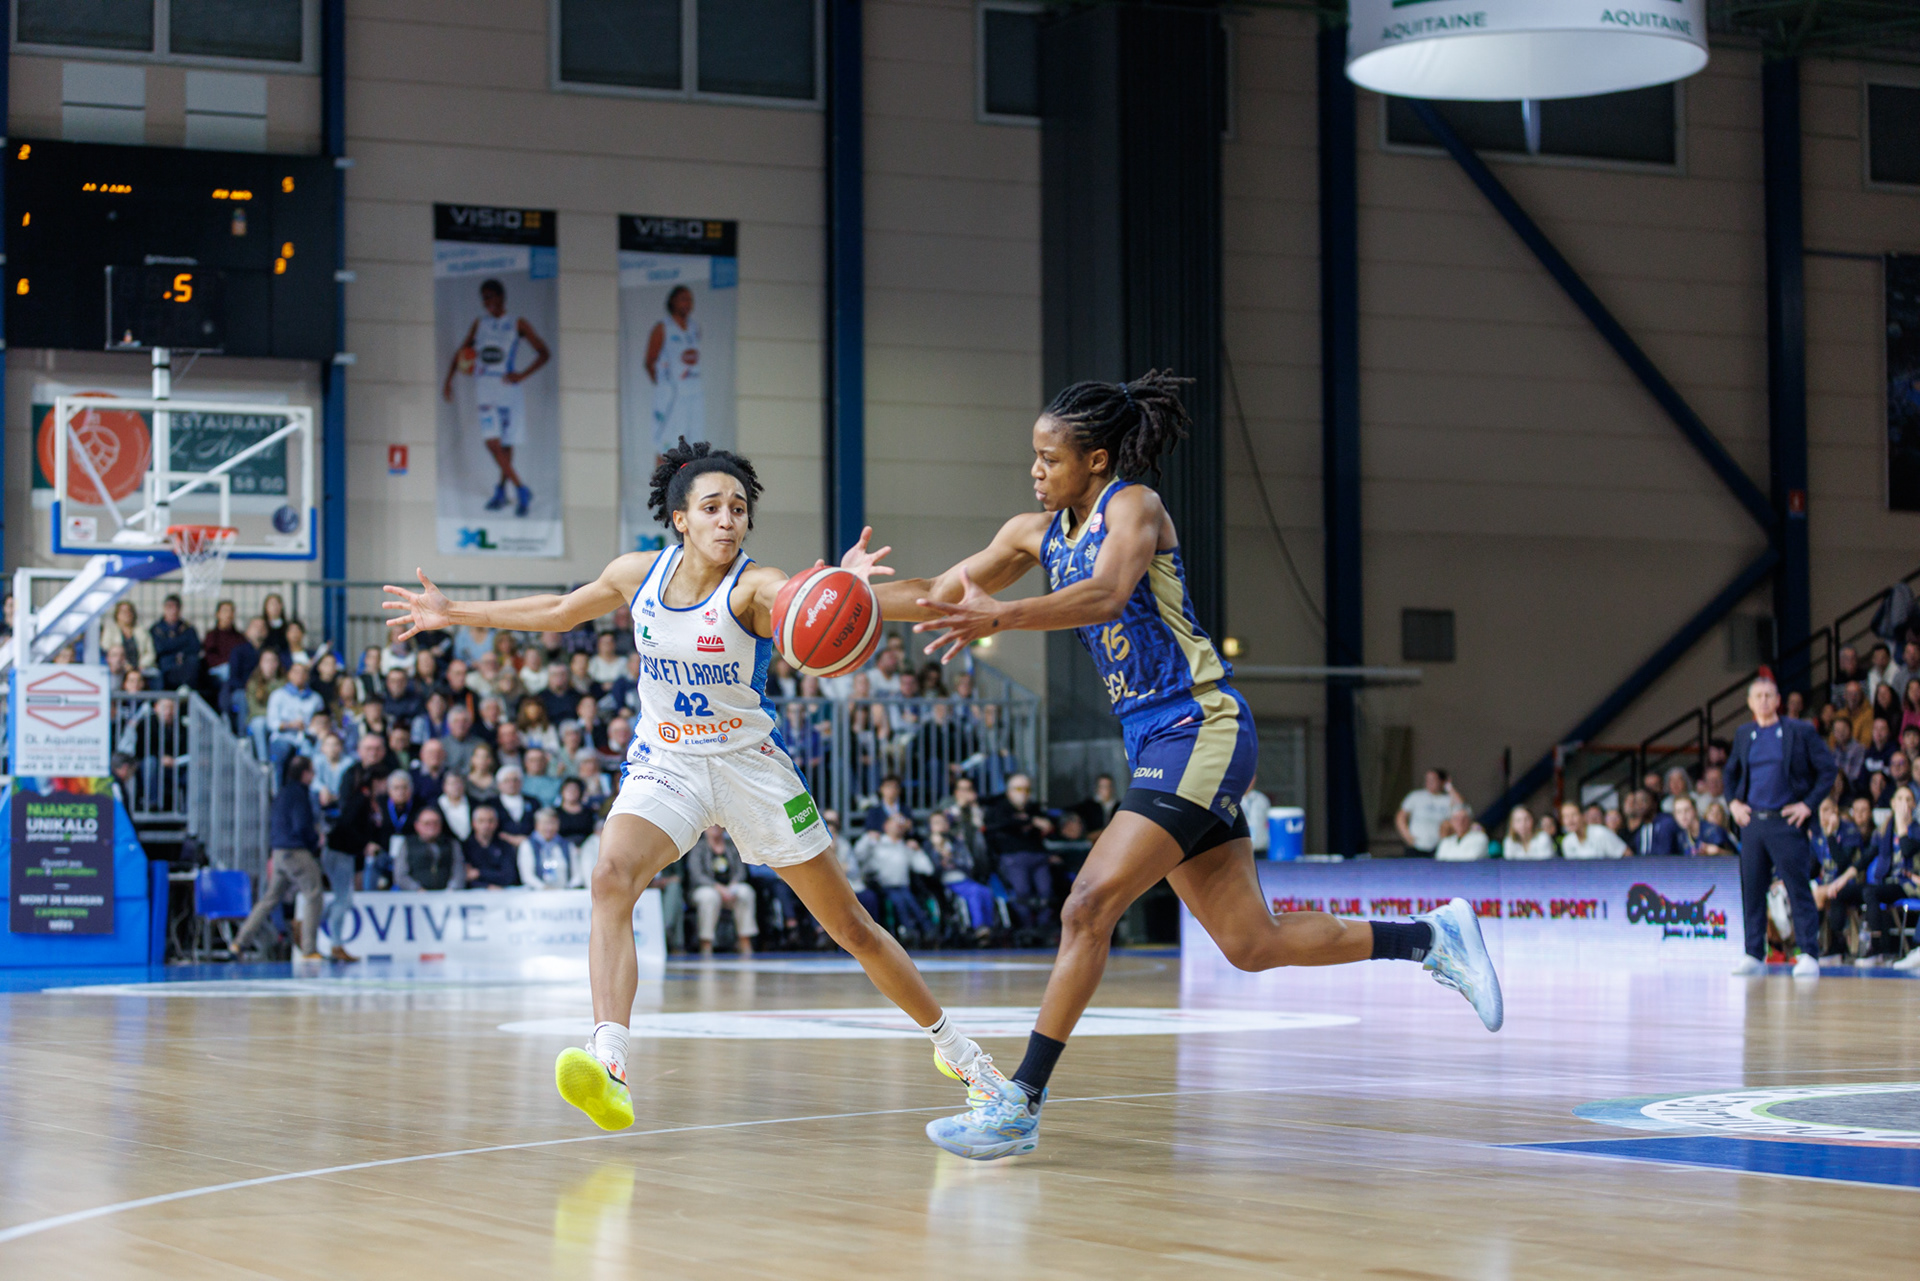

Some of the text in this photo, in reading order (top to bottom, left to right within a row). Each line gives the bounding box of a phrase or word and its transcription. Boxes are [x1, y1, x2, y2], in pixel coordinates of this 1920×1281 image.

[1381, 11, 1488, 41] AQUITAINE
[1600, 8, 1693, 37] AQUITAINE
[170, 412, 284, 431] ESTAURANT
[832, 602, 863, 648] molten
[1101, 622, 1131, 662] 15
[682, 661, 741, 686] LANDES
[673, 690, 715, 718] 42
[682, 717, 743, 736] BRICO
[26, 803, 98, 818] NUANCES
[791, 806, 813, 824] mgen
[26, 817, 98, 833] UNIKALO
[505, 908, 526, 922] LA
[531, 907, 584, 922] TRUITE
[1549, 898, 1598, 919] SPORT
